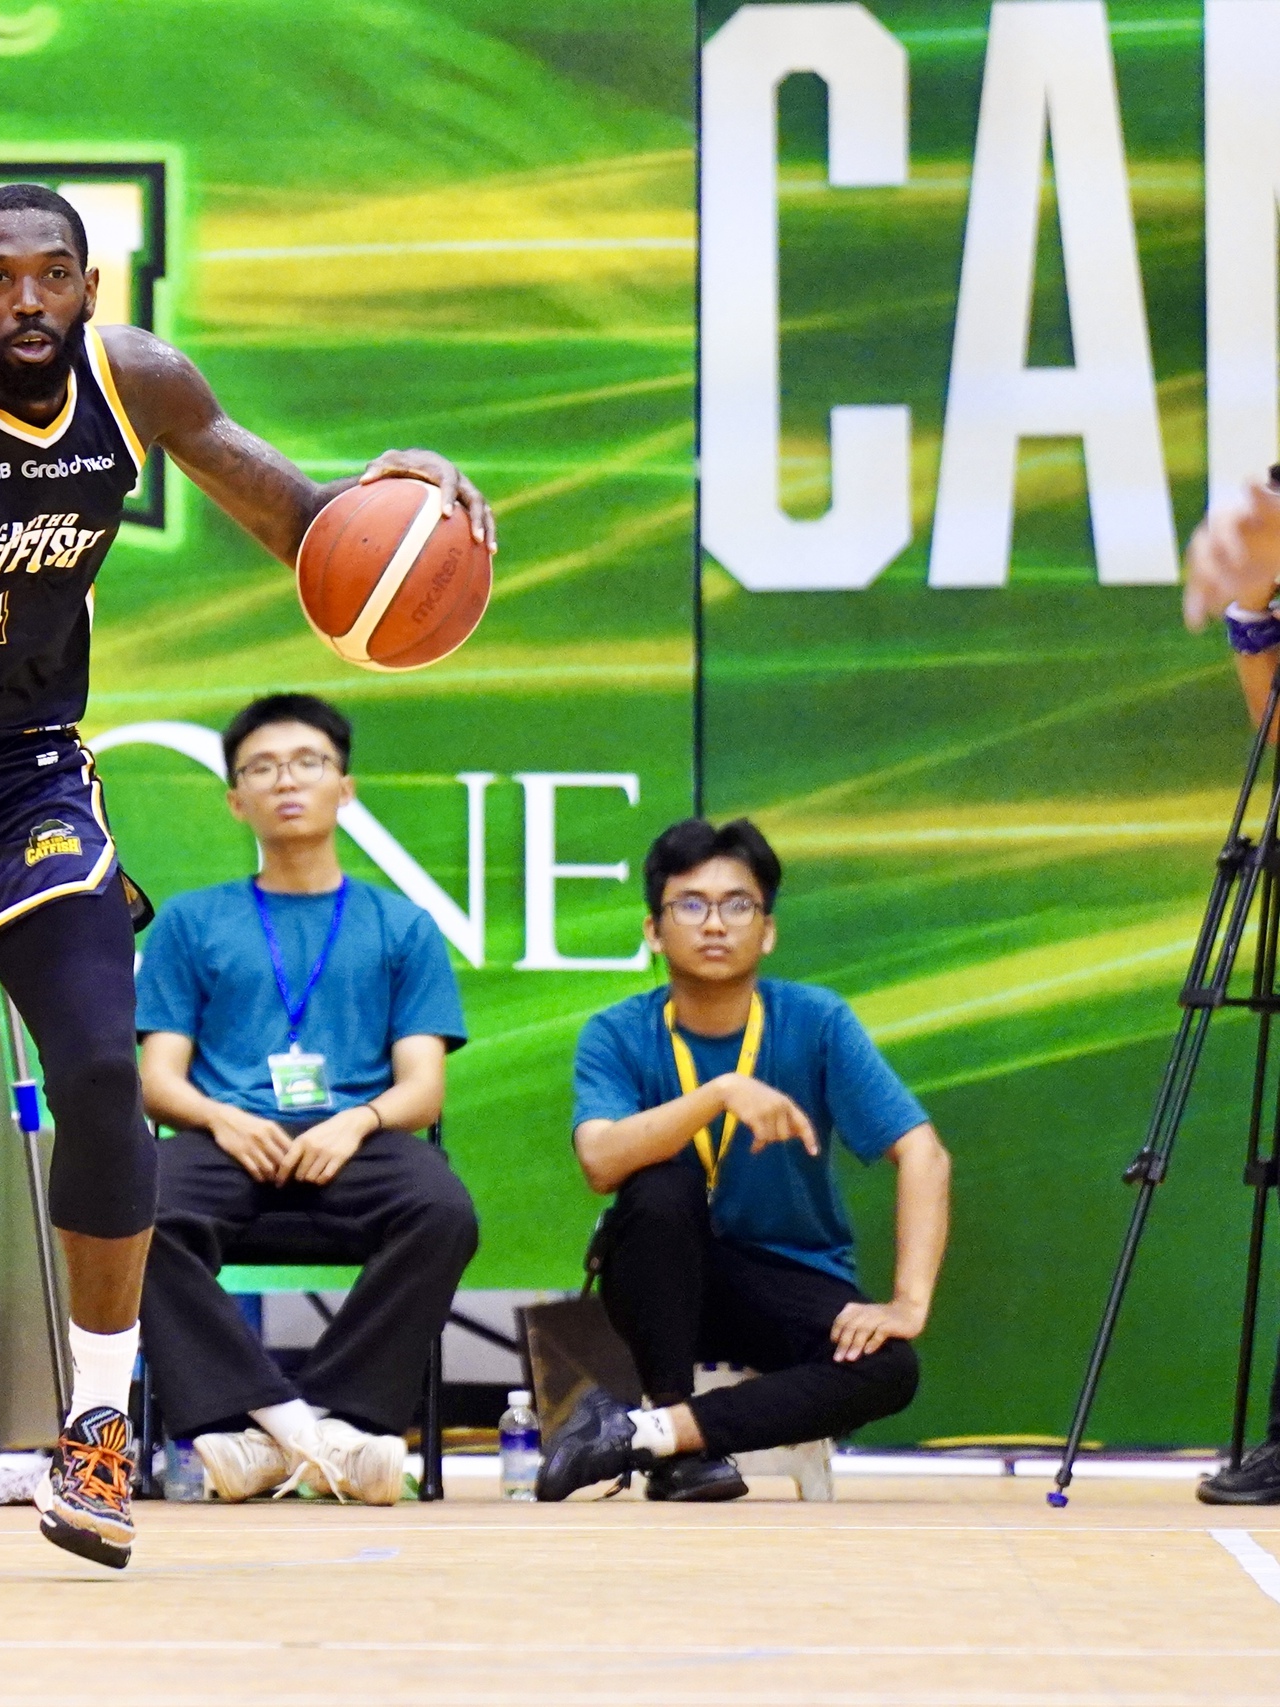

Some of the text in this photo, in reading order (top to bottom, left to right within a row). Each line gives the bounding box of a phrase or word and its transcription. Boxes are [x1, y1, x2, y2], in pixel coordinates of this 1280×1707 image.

[21, 458, 69, 479] Grab
[34, 513, 79, 529] THO
[27, 837, 80, 865] CATFISH
